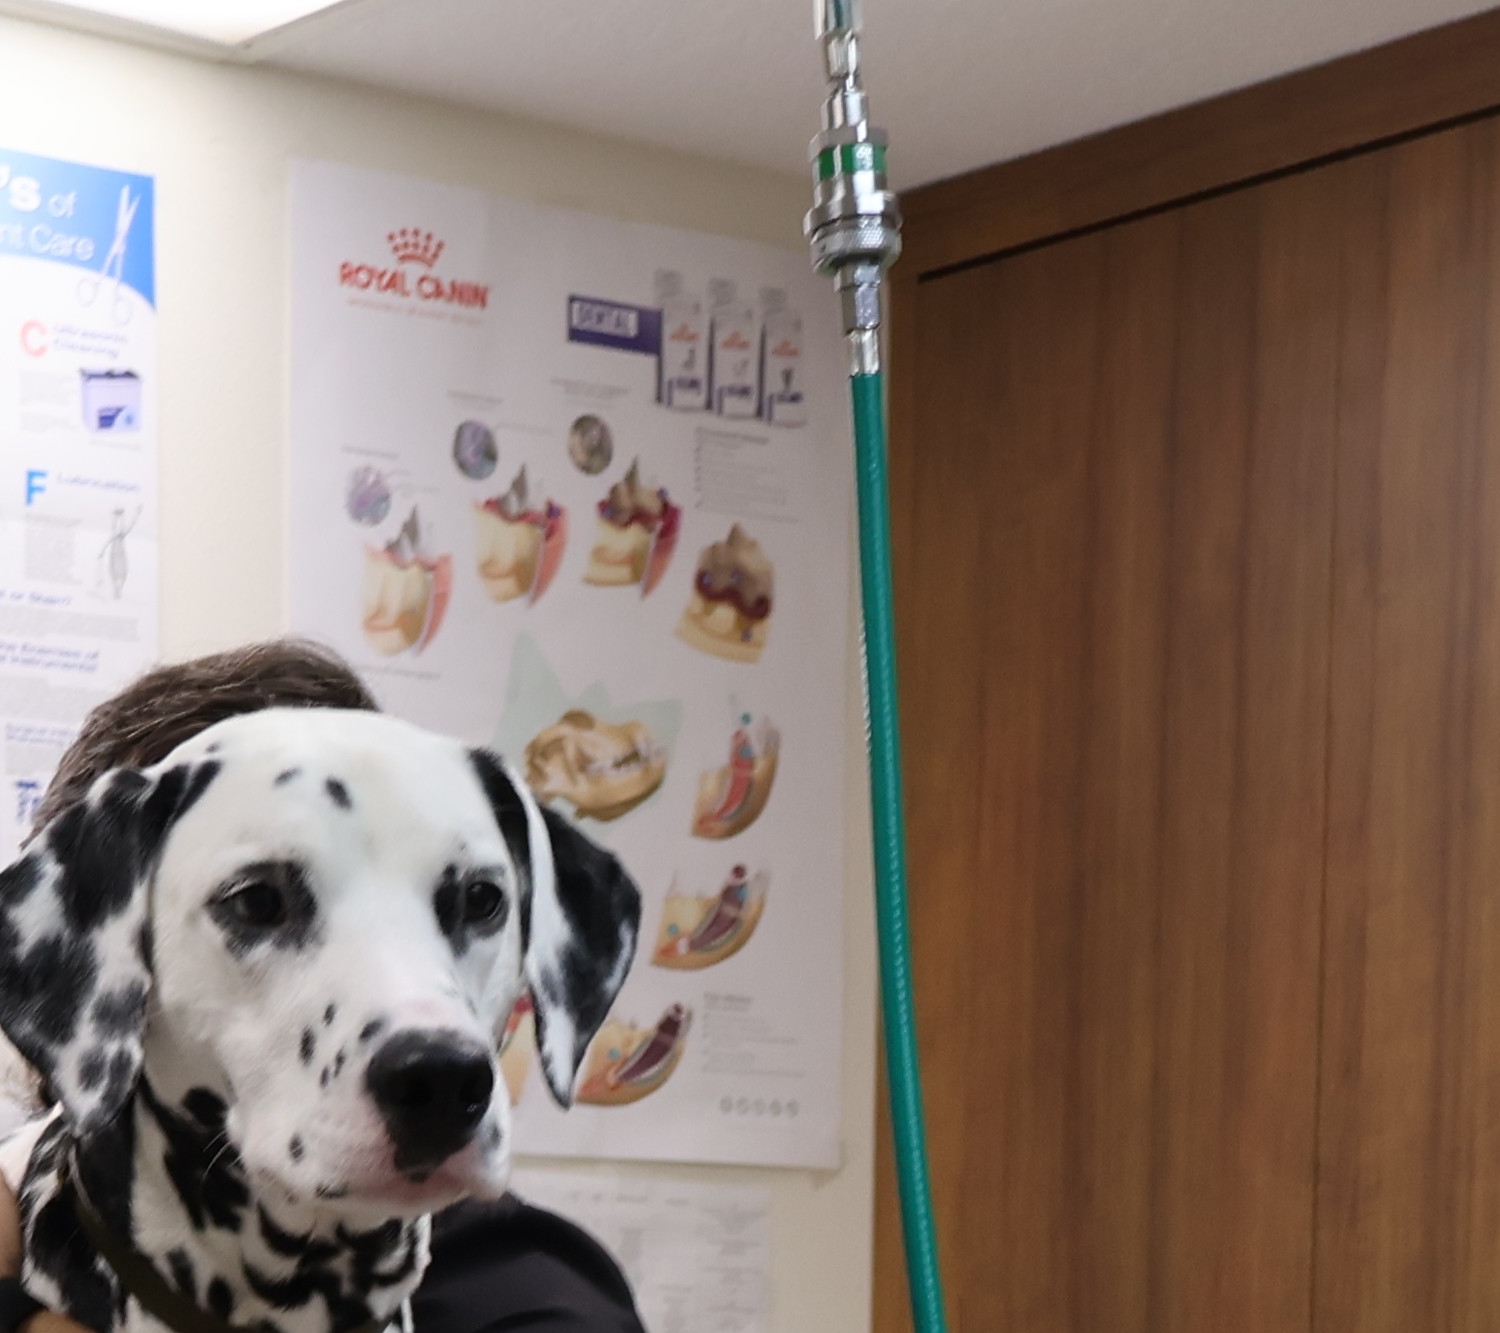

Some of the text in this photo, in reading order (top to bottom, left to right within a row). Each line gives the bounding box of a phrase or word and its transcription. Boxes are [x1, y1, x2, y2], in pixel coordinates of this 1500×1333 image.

[29, 223, 96, 262] Care
[340, 261, 490, 310] ROYAL CANIN
[19, 318, 48, 358] C
[25, 467, 49, 508] F
